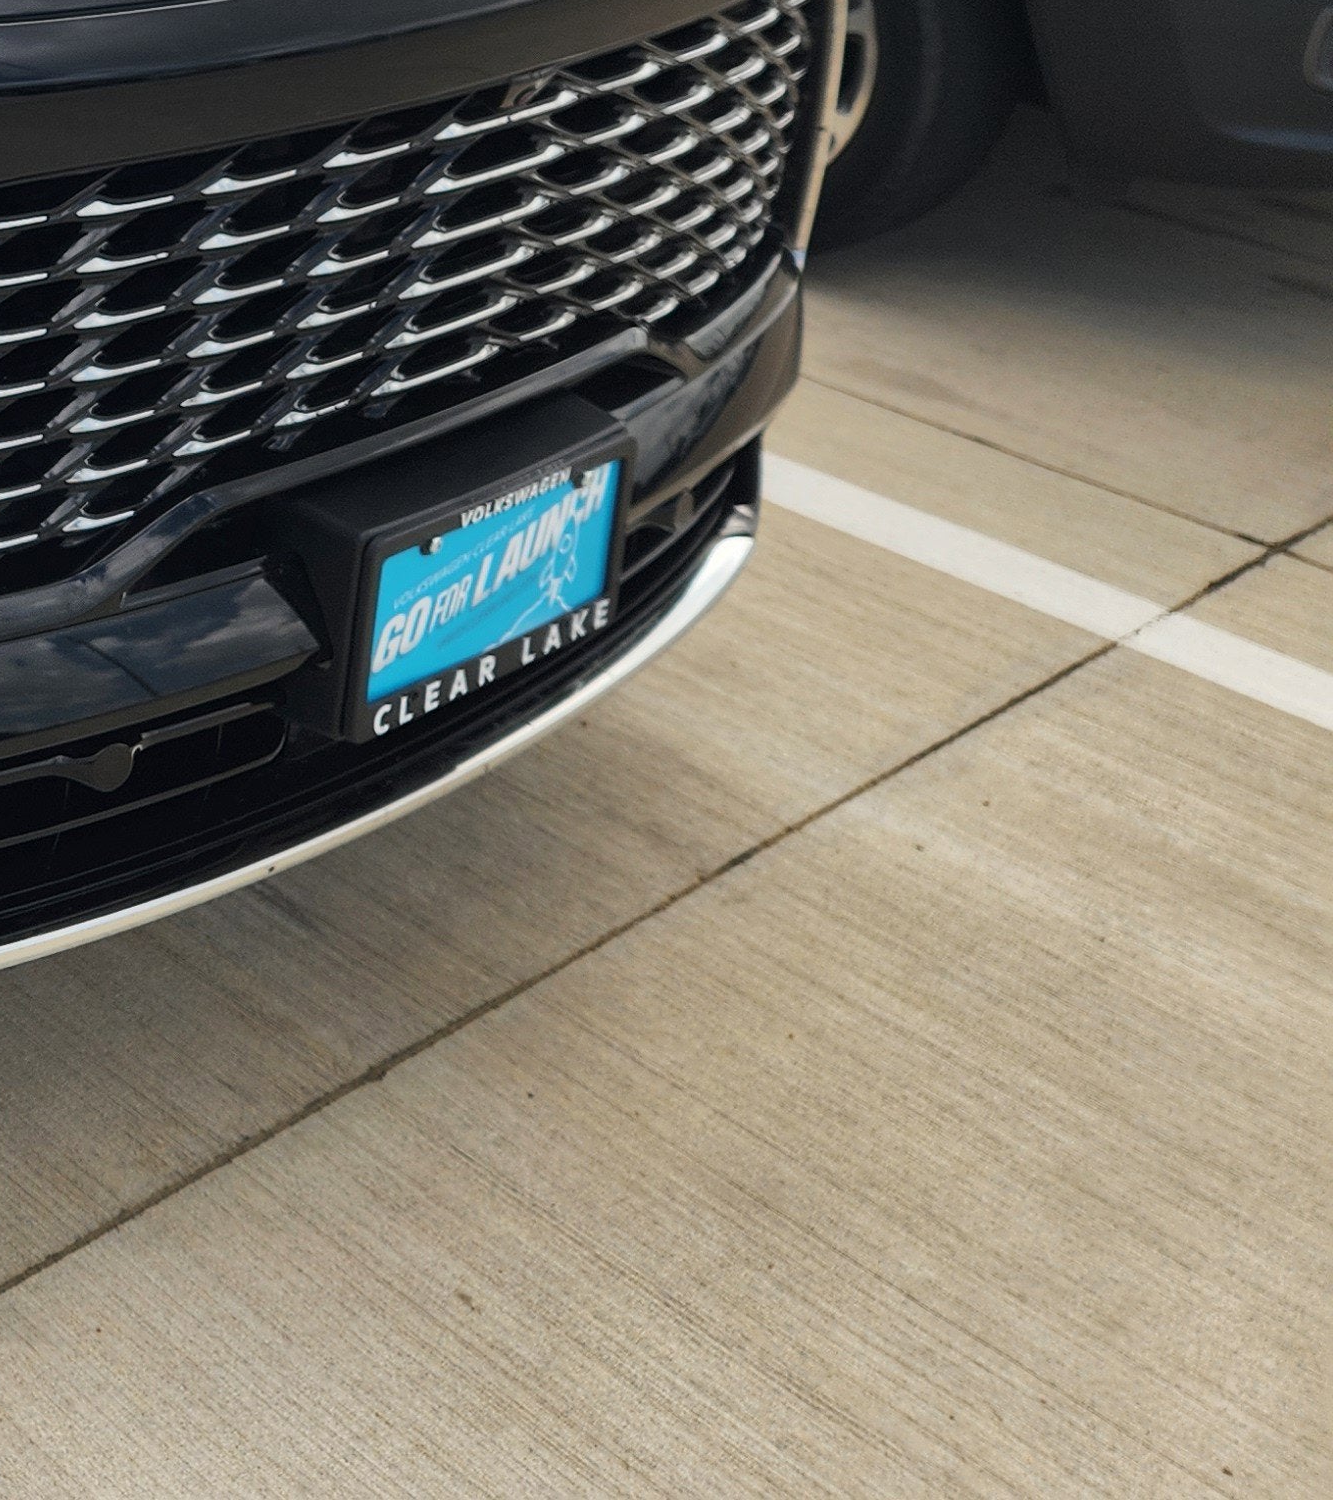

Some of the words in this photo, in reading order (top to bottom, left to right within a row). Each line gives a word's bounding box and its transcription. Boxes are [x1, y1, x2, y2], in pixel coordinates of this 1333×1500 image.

[460, 466, 572, 528] VOLKSWAGEN
[371, 596, 432, 674] GO
[429, 573, 473, 633] FOR
[471, 462, 611, 607] LAUNCH
[373, 654, 497, 737] CLEAR
[521, 598, 610, 666] LAKE
